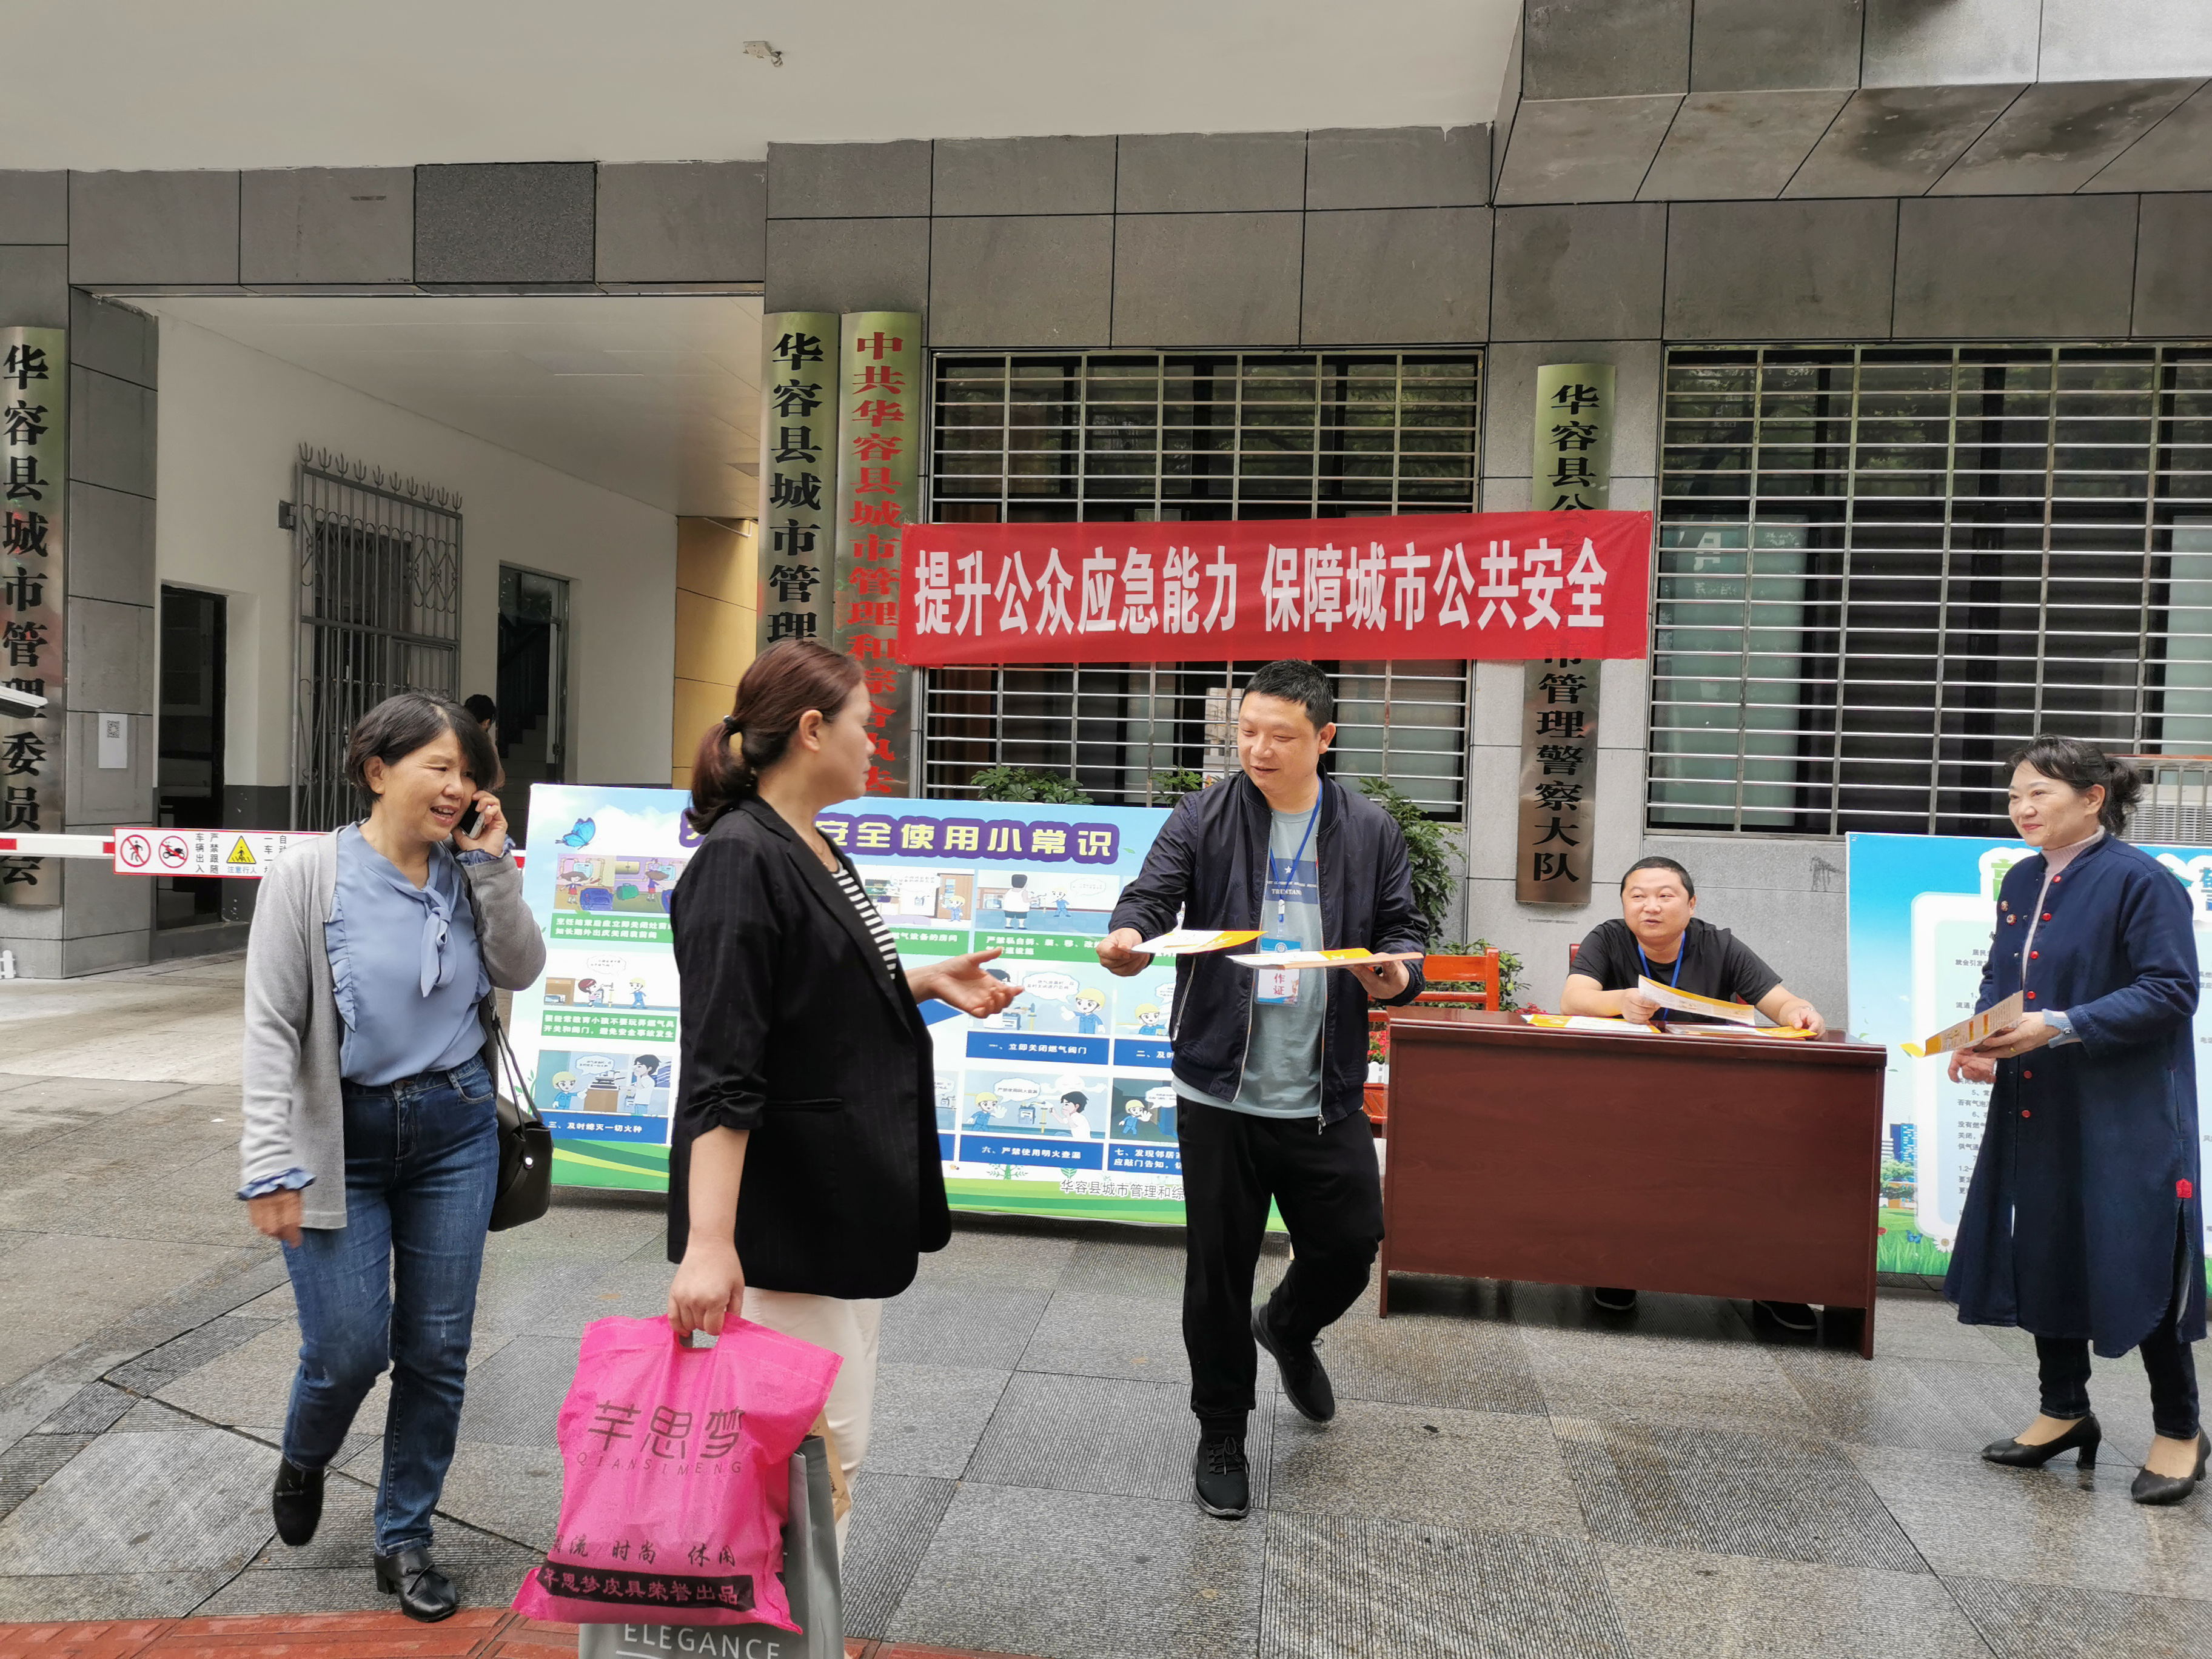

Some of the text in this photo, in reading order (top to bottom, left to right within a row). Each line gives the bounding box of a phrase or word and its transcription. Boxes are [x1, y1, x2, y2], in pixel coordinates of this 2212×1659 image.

[914, 537, 1607, 636] 提升公众应急能力 保障城市公共安全
[577, 1452, 742, 1475] QIANSIMENG
[624, 1623, 780, 1659] ELEGANCE
